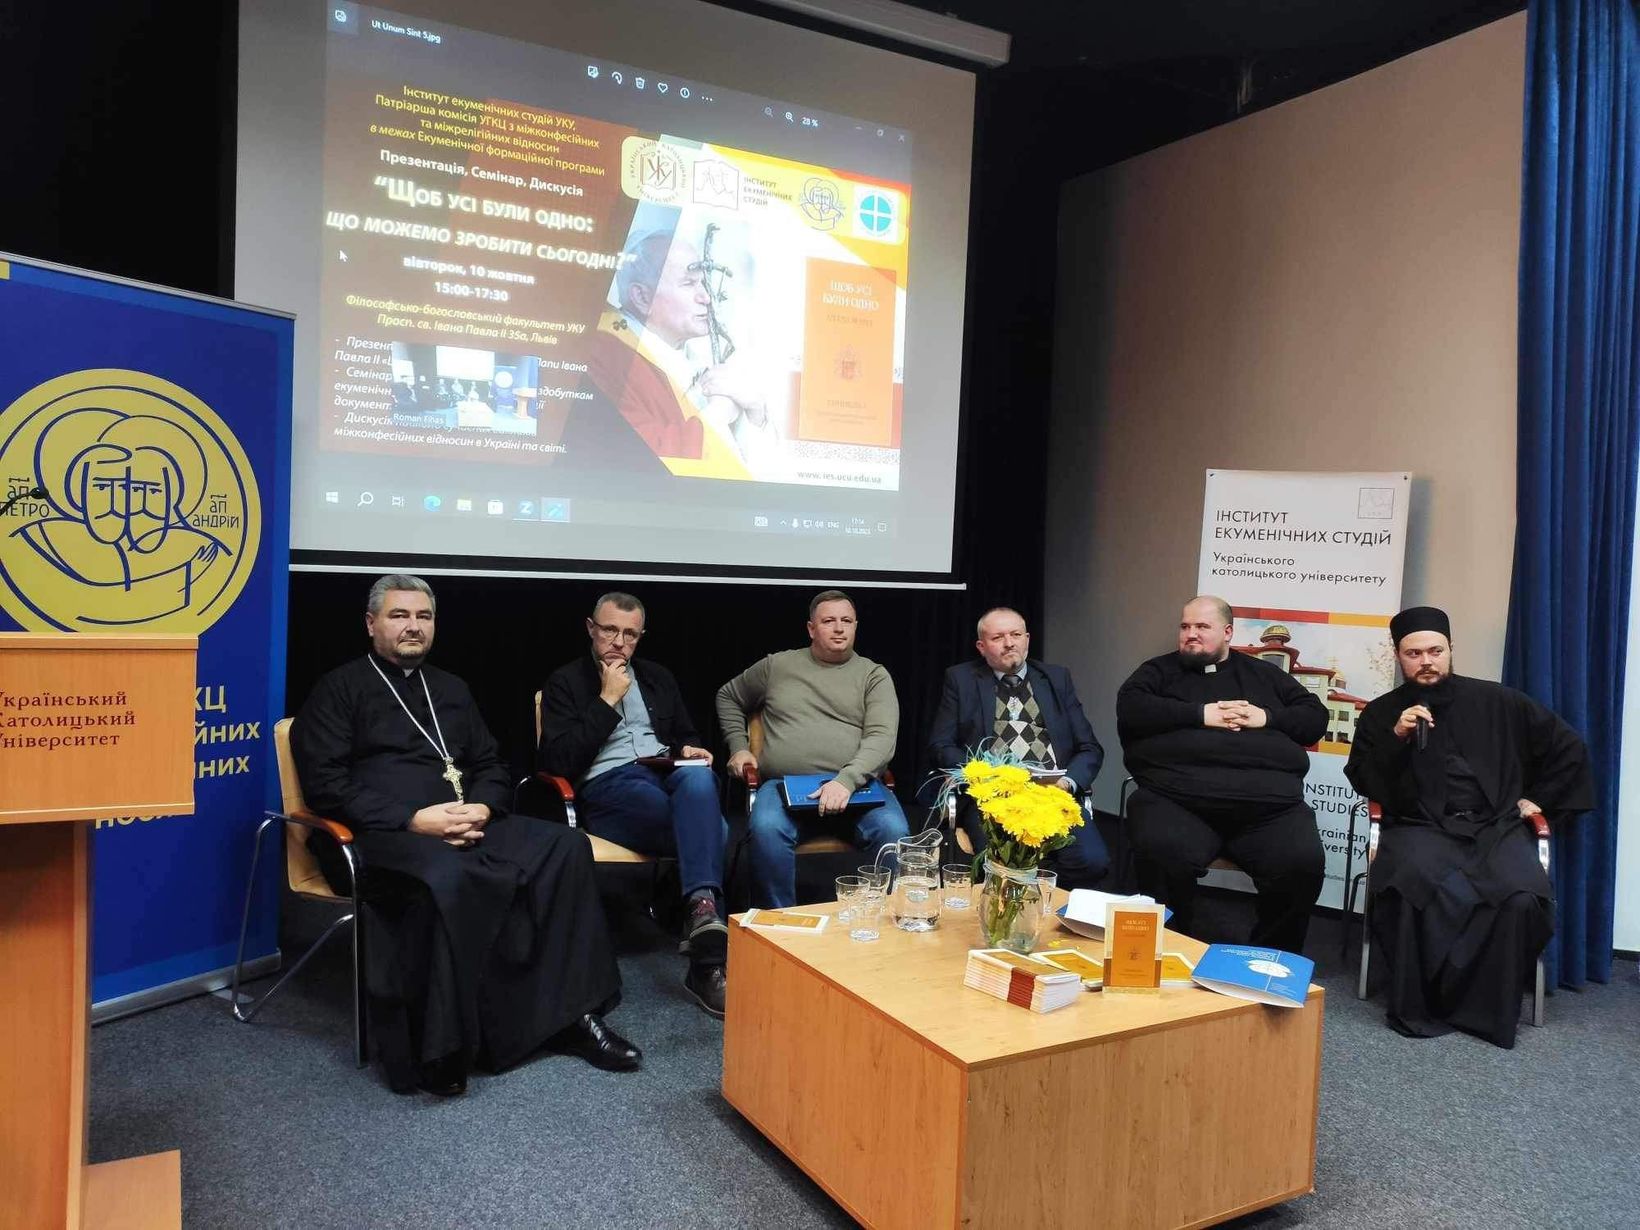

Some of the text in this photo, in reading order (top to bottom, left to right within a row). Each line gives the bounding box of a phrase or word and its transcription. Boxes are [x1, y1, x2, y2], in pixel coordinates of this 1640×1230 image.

[382, 22, 405, 34] Unum
[406, 27, 422, 38] Sint
[403, 85, 576, 131] Інститут екуменічних студій УКУ,
[375, 94, 600, 149] Патріарша комісія УГКЦ з міжконфесійних
[420, 119, 560, 154] та міжрелігійних відносин
[369, 124, 605, 176] в межах Екуменічної формаційної програми
[380, 149, 584, 197] Презентація, Семінар, Дискусія
[482, 199, 530, 222] БУЛИ
[534, 209, 593, 233] ОДНО:
[325, 211, 360, 231] ЩО
[363, 217, 451, 243] МОЖЕМО
[455, 230, 533, 257] ЗРОБИТИ
[403, 255, 536, 285] вівторок, 10 жовтня
[434, 281, 509, 302] 15:00-17:30
[346, 294, 586, 334] Філософсько-богословський факультет УКУ
[377, 313, 415, 328] Просп.
[417, 320, 432, 330] св.
[434, 320, 463, 333] Івана
[465, 324, 498, 338] Павла
[530, 332, 558, 345] Львів
[334, 350, 371, 364] Павла
[561, 360, 587, 372] Івана
[334, 382, 392, 396] екуменічн
[334, 394, 392, 410] документ
[334, 427, 424, 443] міжконфесійних
[426, 433, 474, 446] відносин
[484, 438, 520, 450] Україні
[521, 442, 538, 451] та
[539, 442, 567, 453] світі.
[1216, 510, 1288, 524] ІНСТИТУТ
[1215, 527, 1392, 547] ЕКУМЕНІЧНИХ СТУДІЙ
[1213, 552, 1295, 566] Українського
[1212, 568, 1387, 587] католицького університету
[0, 691, 127, 711] країнський
[0, 733, 120, 751] ніверситет
[1305, 783, 1361, 800] NSTITU
